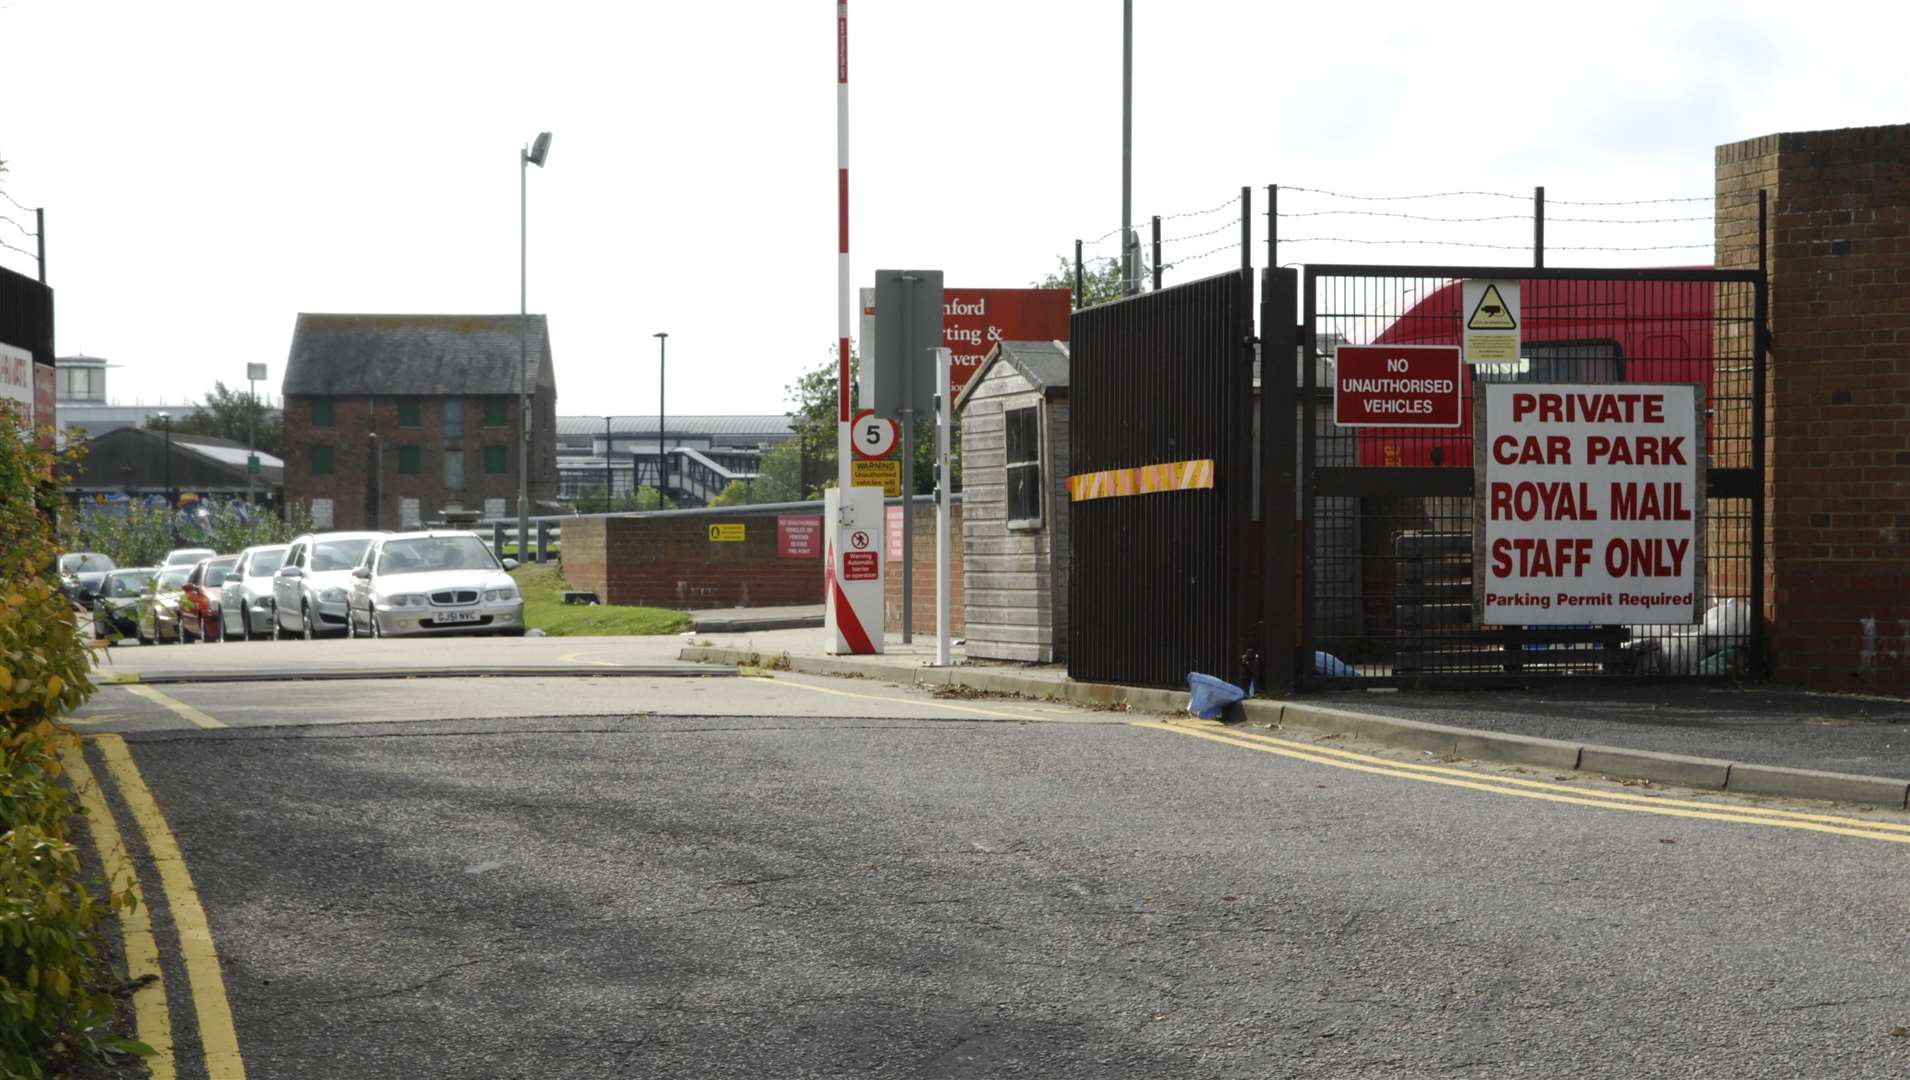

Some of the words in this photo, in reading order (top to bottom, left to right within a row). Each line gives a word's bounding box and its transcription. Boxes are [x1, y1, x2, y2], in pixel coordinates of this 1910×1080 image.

[943, 324, 982, 346] ting
[987, 325, 1003, 342] &
[1387, 358, 1409, 373] NO
[1342, 378, 1454, 394] UNAUTHORISED
[1363, 399, 1433, 414] VEHICLES
[1512, 393, 1665, 424] PRIVATE
[866, 425, 881, 445] 5
[1492, 434, 1572, 466] CAR
[1586, 435, 1687, 466] PARK
[1491, 481, 1598, 522] ROYAL
[1610, 482, 1692, 521] MAIL
[1491, 537, 1593, 579] STAFF
[1604, 537, 1690, 579] ONLY
[1486, 593, 1550, 609] Parking
[1557, 592, 1613, 606] Permit
[1619, 592, 1693, 608] Required
